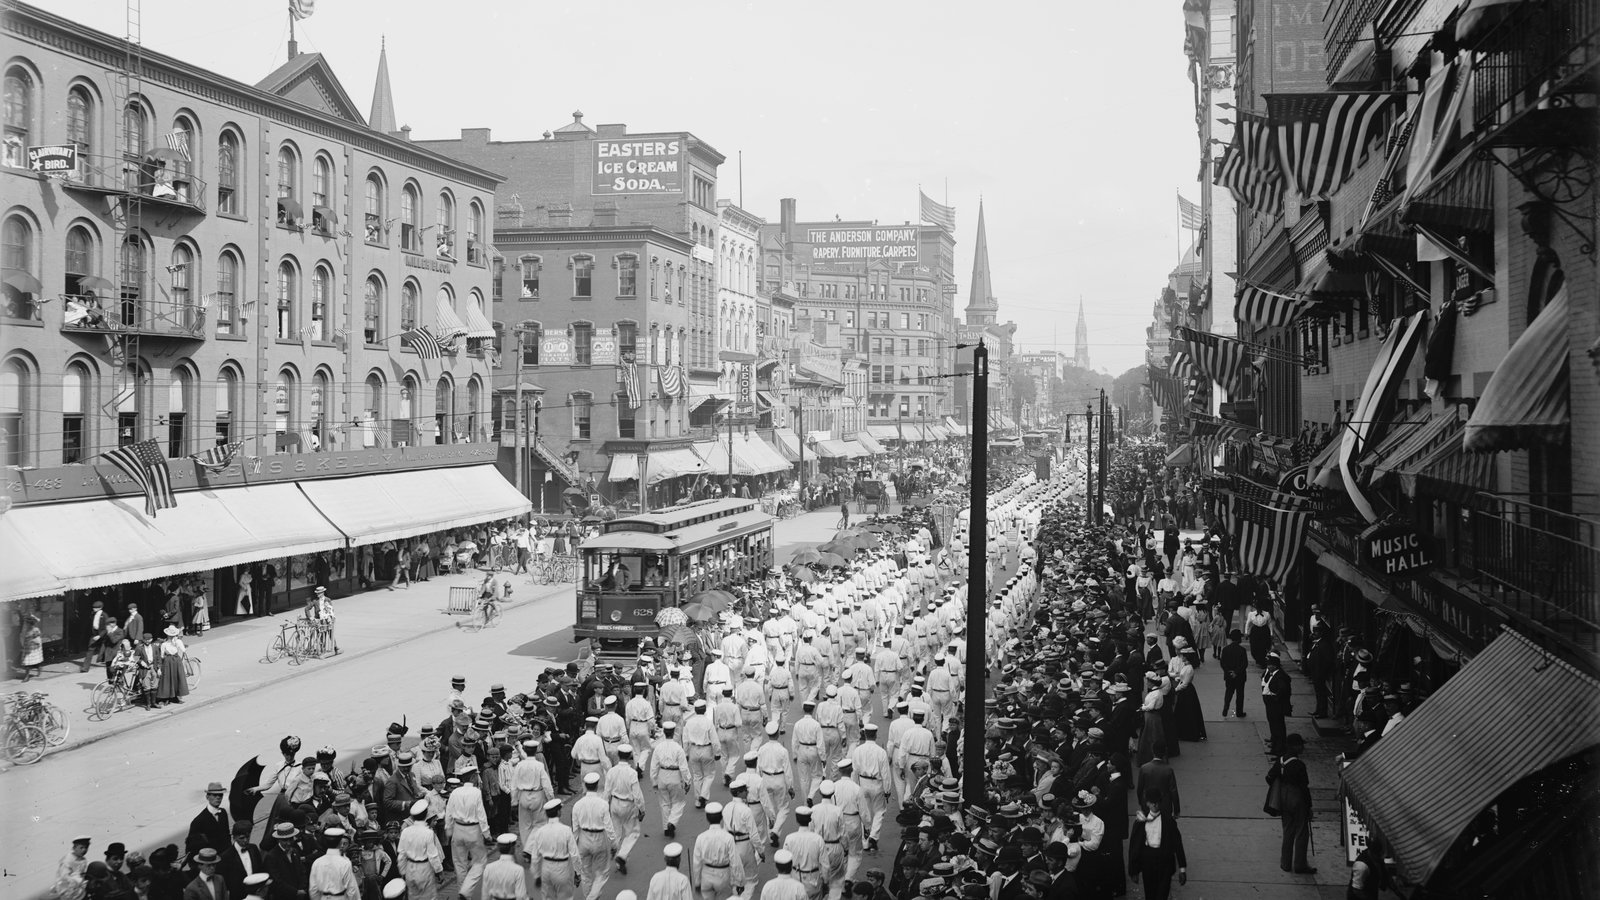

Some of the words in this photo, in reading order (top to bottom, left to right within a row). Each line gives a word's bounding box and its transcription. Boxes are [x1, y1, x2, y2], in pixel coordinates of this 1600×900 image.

[598, 141, 680, 157] EASTERS
[45, 160, 70, 169] BIRD.
[598, 161, 623, 174] ICE
[626, 160, 678, 175] CREAM
[612, 177, 666, 191] SODA.
[811, 231, 827, 243] THE
[829, 230, 872, 243] ANDERSON
[813, 247, 841, 258] RAPERY.
[883, 245, 917, 257] CARPETS
[294, 460, 306, 472] &
[317, 453, 393, 472] KELLY
[1371, 533, 1419, 558] MUSIC
[1386, 551, 1433, 574] HALL.
[633, 608, 653, 617] 628
[1411, 580, 1440, 616] MUSIC
[1442, 599, 1475, 640] HALL
